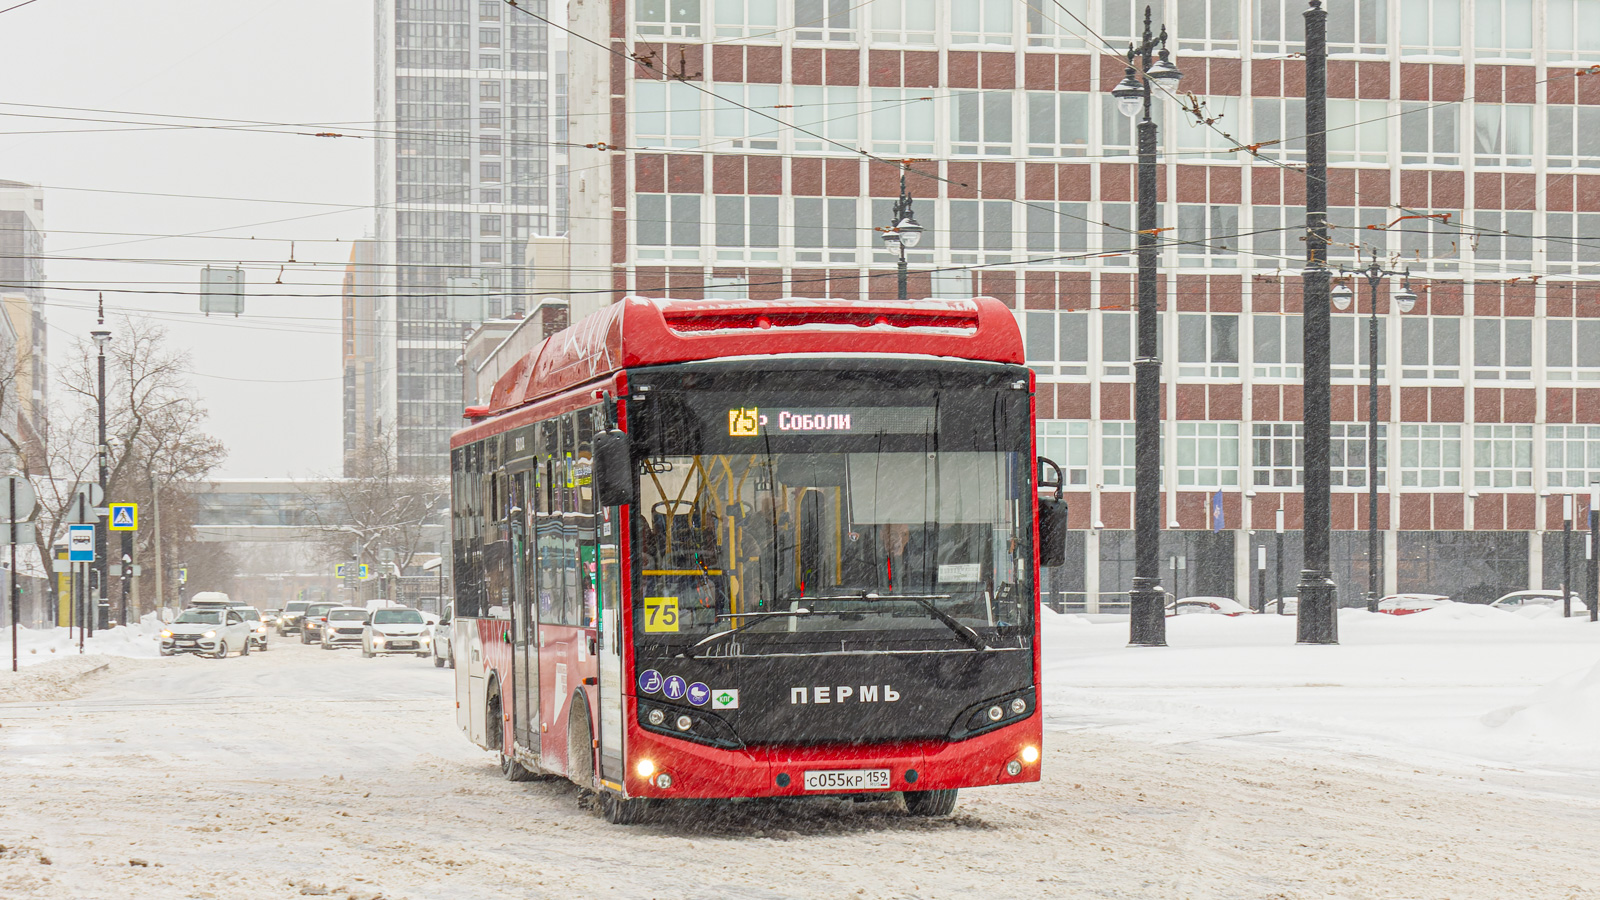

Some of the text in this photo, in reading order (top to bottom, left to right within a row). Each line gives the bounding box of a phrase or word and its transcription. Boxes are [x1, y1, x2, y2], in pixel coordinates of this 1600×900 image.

[730, 407, 757, 433] 75
[646, 604, 677, 626] 75
[790, 684, 901, 705] ПЕРМЬ
[866, 771, 886, 782] 159
